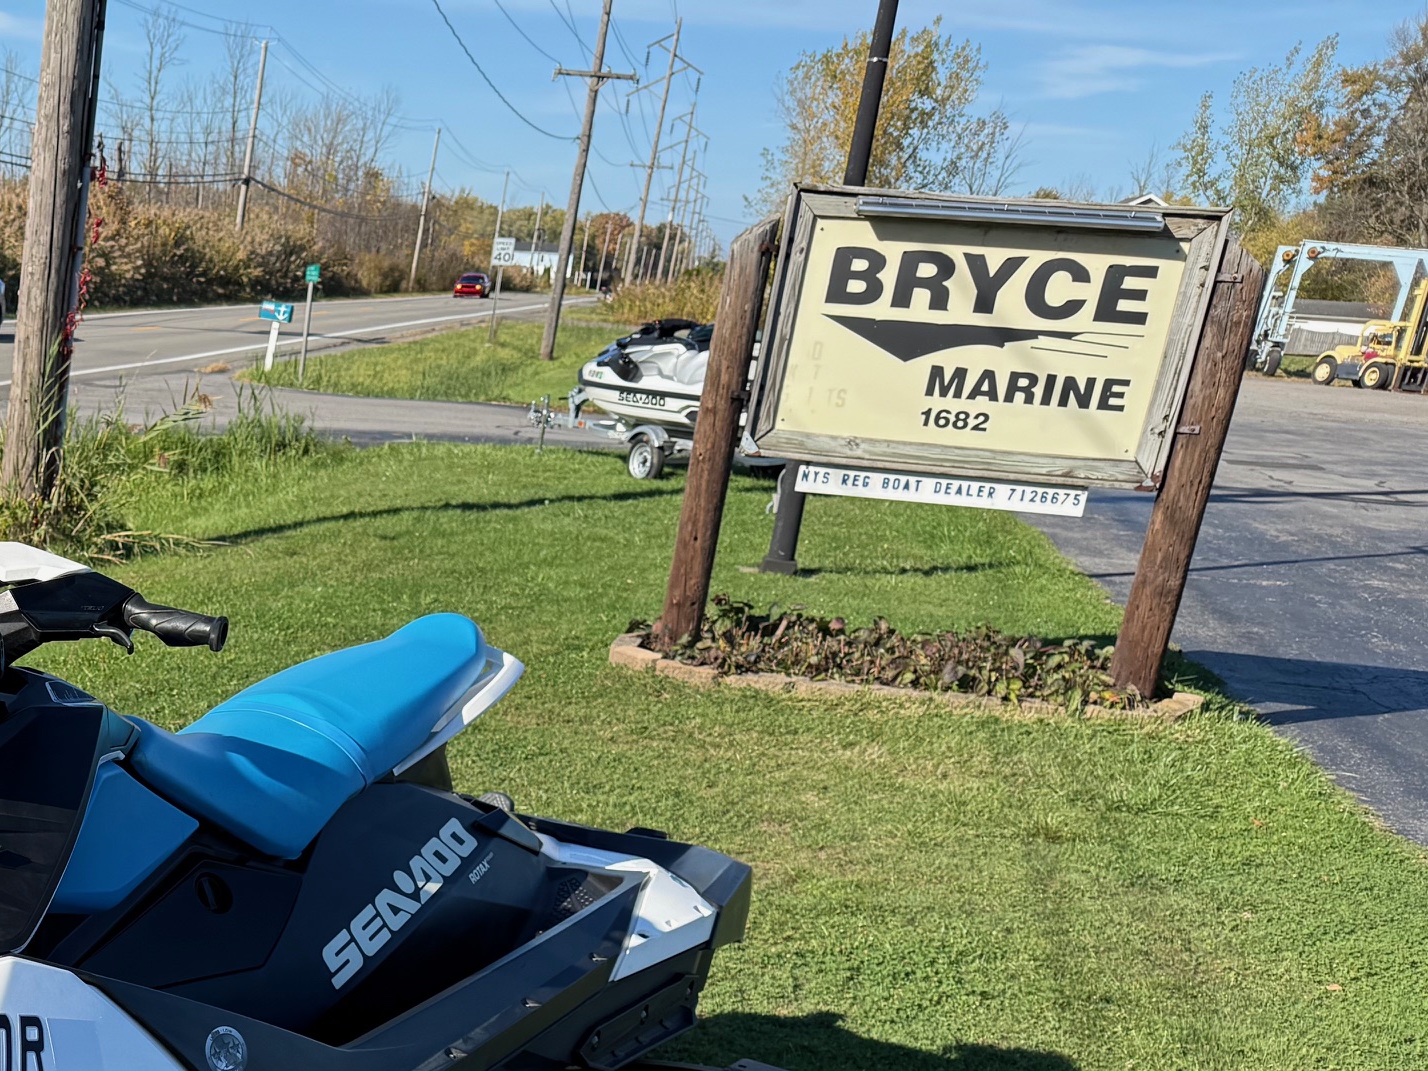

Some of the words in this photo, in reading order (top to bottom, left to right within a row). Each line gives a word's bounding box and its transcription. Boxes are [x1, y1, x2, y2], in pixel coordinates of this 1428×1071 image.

[494, 252, 511, 262] 40
[823, 246, 1160, 326] BRYCE
[924, 364, 1132, 413] MARINE
[920, 408, 990, 433] 1682
[801, 469, 830, 484] NYS
[841, 473, 871, 488] REG
[881, 477, 923, 492] BOAT
[933, 481, 996, 499] DEALER
[1007, 488, 1082, 506] 7126675
[468, 858, 491, 885] ROTAX
